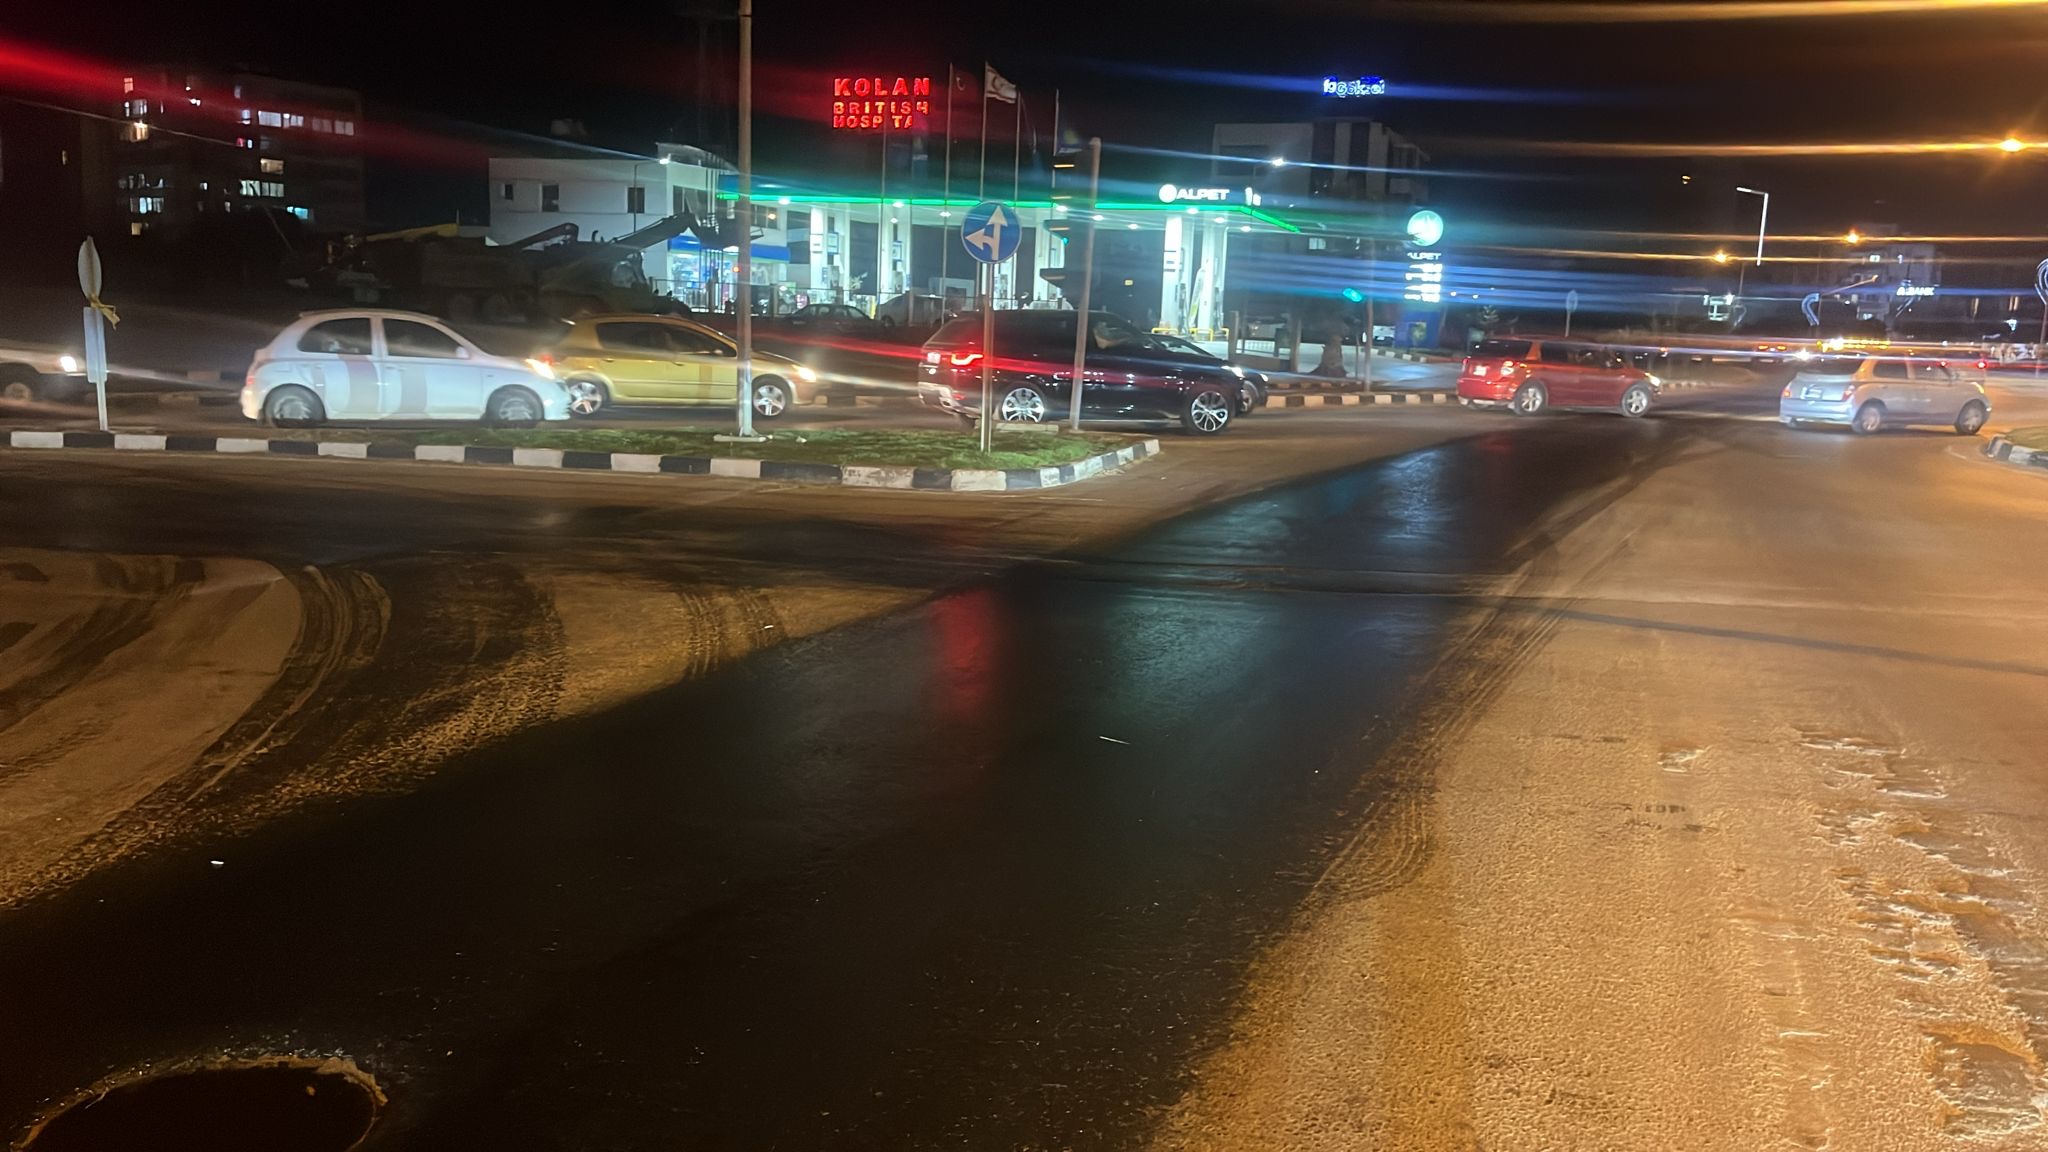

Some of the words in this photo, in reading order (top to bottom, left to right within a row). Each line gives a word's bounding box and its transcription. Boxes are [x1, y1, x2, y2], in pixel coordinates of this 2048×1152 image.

[834, 77, 930, 97] KOLAN
[833, 101, 929, 115] BRITISH
[833, 115, 913, 128] HOSPTA
[1176, 188, 1230, 201] ALPET
